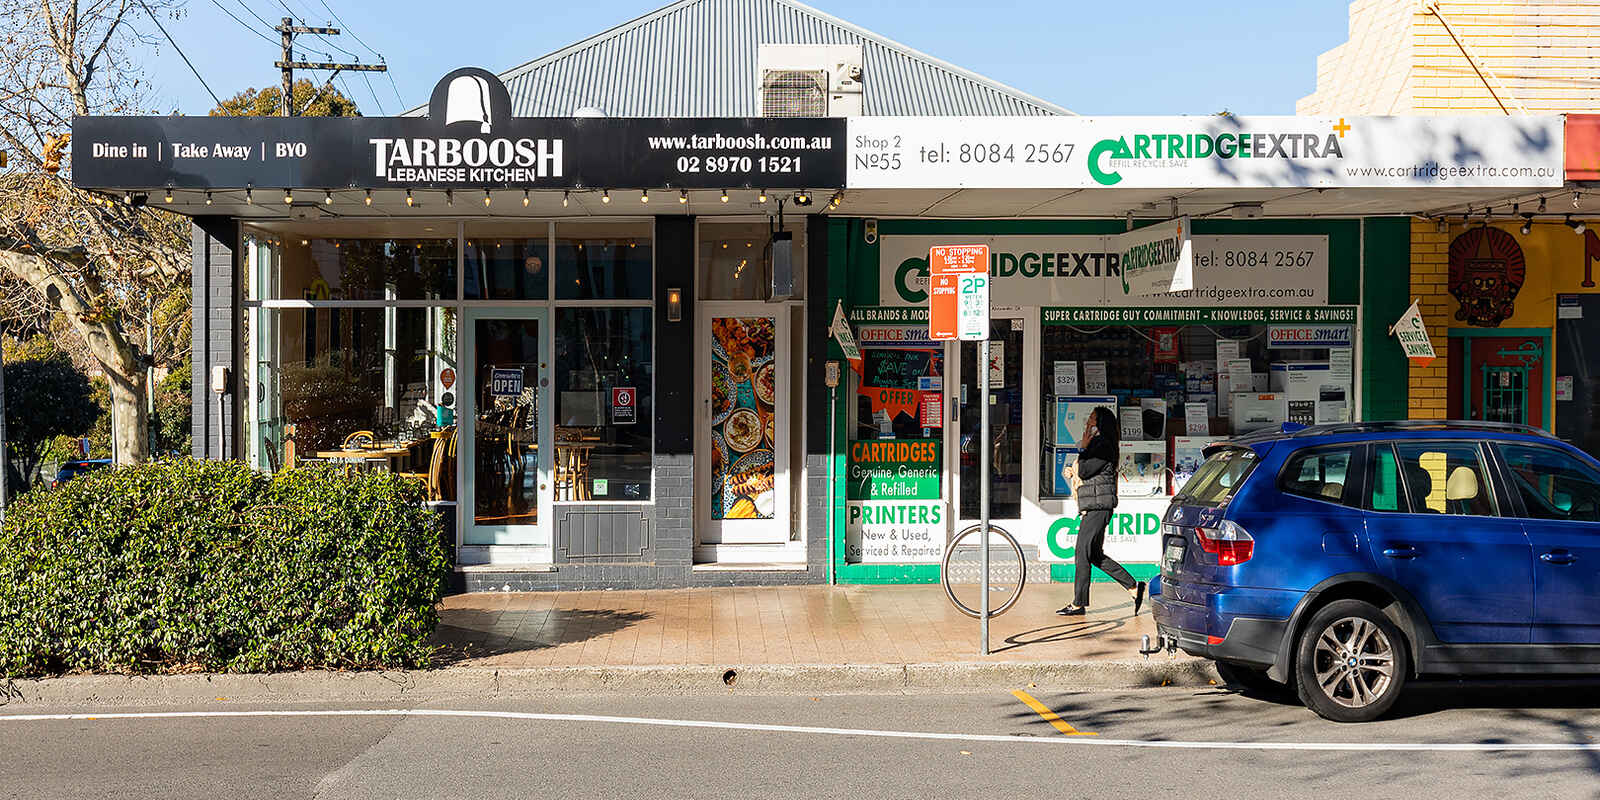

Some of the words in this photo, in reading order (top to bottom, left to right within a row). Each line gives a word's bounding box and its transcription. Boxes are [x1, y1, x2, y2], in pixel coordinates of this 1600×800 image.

[648, 133, 832, 151] www.tarboosh.com.au
[855, 135, 888, 151] Shop
[894, 135, 901, 148] 2
[92, 143, 128, 158] Dine
[132, 143, 147, 158] in
[173, 143, 208, 158] Take
[212, 143, 251, 160] Away
[276, 143, 307, 158] BYO
[369, 138, 563, 177] TARBOOSH
[920, 143, 950, 163] tel:
[960, 143, 1015, 163] 8084
[1024, 143, 1075, 163] 2567
[677, 156, 699, 173] 02
[705, 156, 751, 173] 8970
[759, 156, 801, 173] 1521
[1346, 162, 1555, 182] www.cartridgeextra.com.au
[388, 168, 465, 182] LEBANESE
[470, 168, 536, 182] KITCHEN
[935, 248, 946, 257] NO
[949, 247, 983, 256] STOPPING
[1195, 250, 1218, 267] tel:
[1225, 250, 1269, 267] 8084
[1275, 250, 1315, 267] 2567
[940, 278, 949, 286] NO
[962, 278, 985, 294] 2P
[933, 287, 956, 295] STOPPING
[1141, 286, 1315, 302] .cartridgeextra.com.au
[850, 310, 870, 321] ALL
[873, 310, 900, 321] BRANDS
[902, 310, 908, 321] &
[910, 310, 929, 321] MOD
[1044, 310, 1070, 321] SUPER
[1073, 310, 1120, 321] CARTRIDGE
[1123, 310, 1140, 321] GUY
[1144, 310, 1201, 321] COMMITMENT
[1211, 310, 1267, 322] KNOWLEDGE,
[1270, 310, 1302, 321] SERVICE
[1305, 310, 1311, 321] &
[1314, 310, 1353, 321] SAVINGS!
[861, 329, 903, 341] OFFICE
[904, 328, 929, 341] sma
[1271, 328, 1313, 340] OFFICE
[1313, 327, 1349, 340] smart
[494, 379, 521, 393] OPEN
[1056, 375, 1075, 384] $329
[880, 389, 913, 406] OFFER
[1122, 427, 1142, 436] $199
[1188, 423, 1207, 432] $299
[852, 442, 936, 463] CARTRIDGES
[852, 465, 895, 480] Genuine,
[898, 465, 937, 478] Generic
[870, 483, 878, 496] &
[881, 482, 918, 496] Refilled
[850, 505, 941, 525] PRINTERS
[862, 529, 885, 540] New
[889, 528, 897, 540] &
[902, 528, 931, 542] Used,
[850, 545, 889, 556] Serviced
[892, 545, 899, 556] &
[901, 544, 941, 559] Repaired
